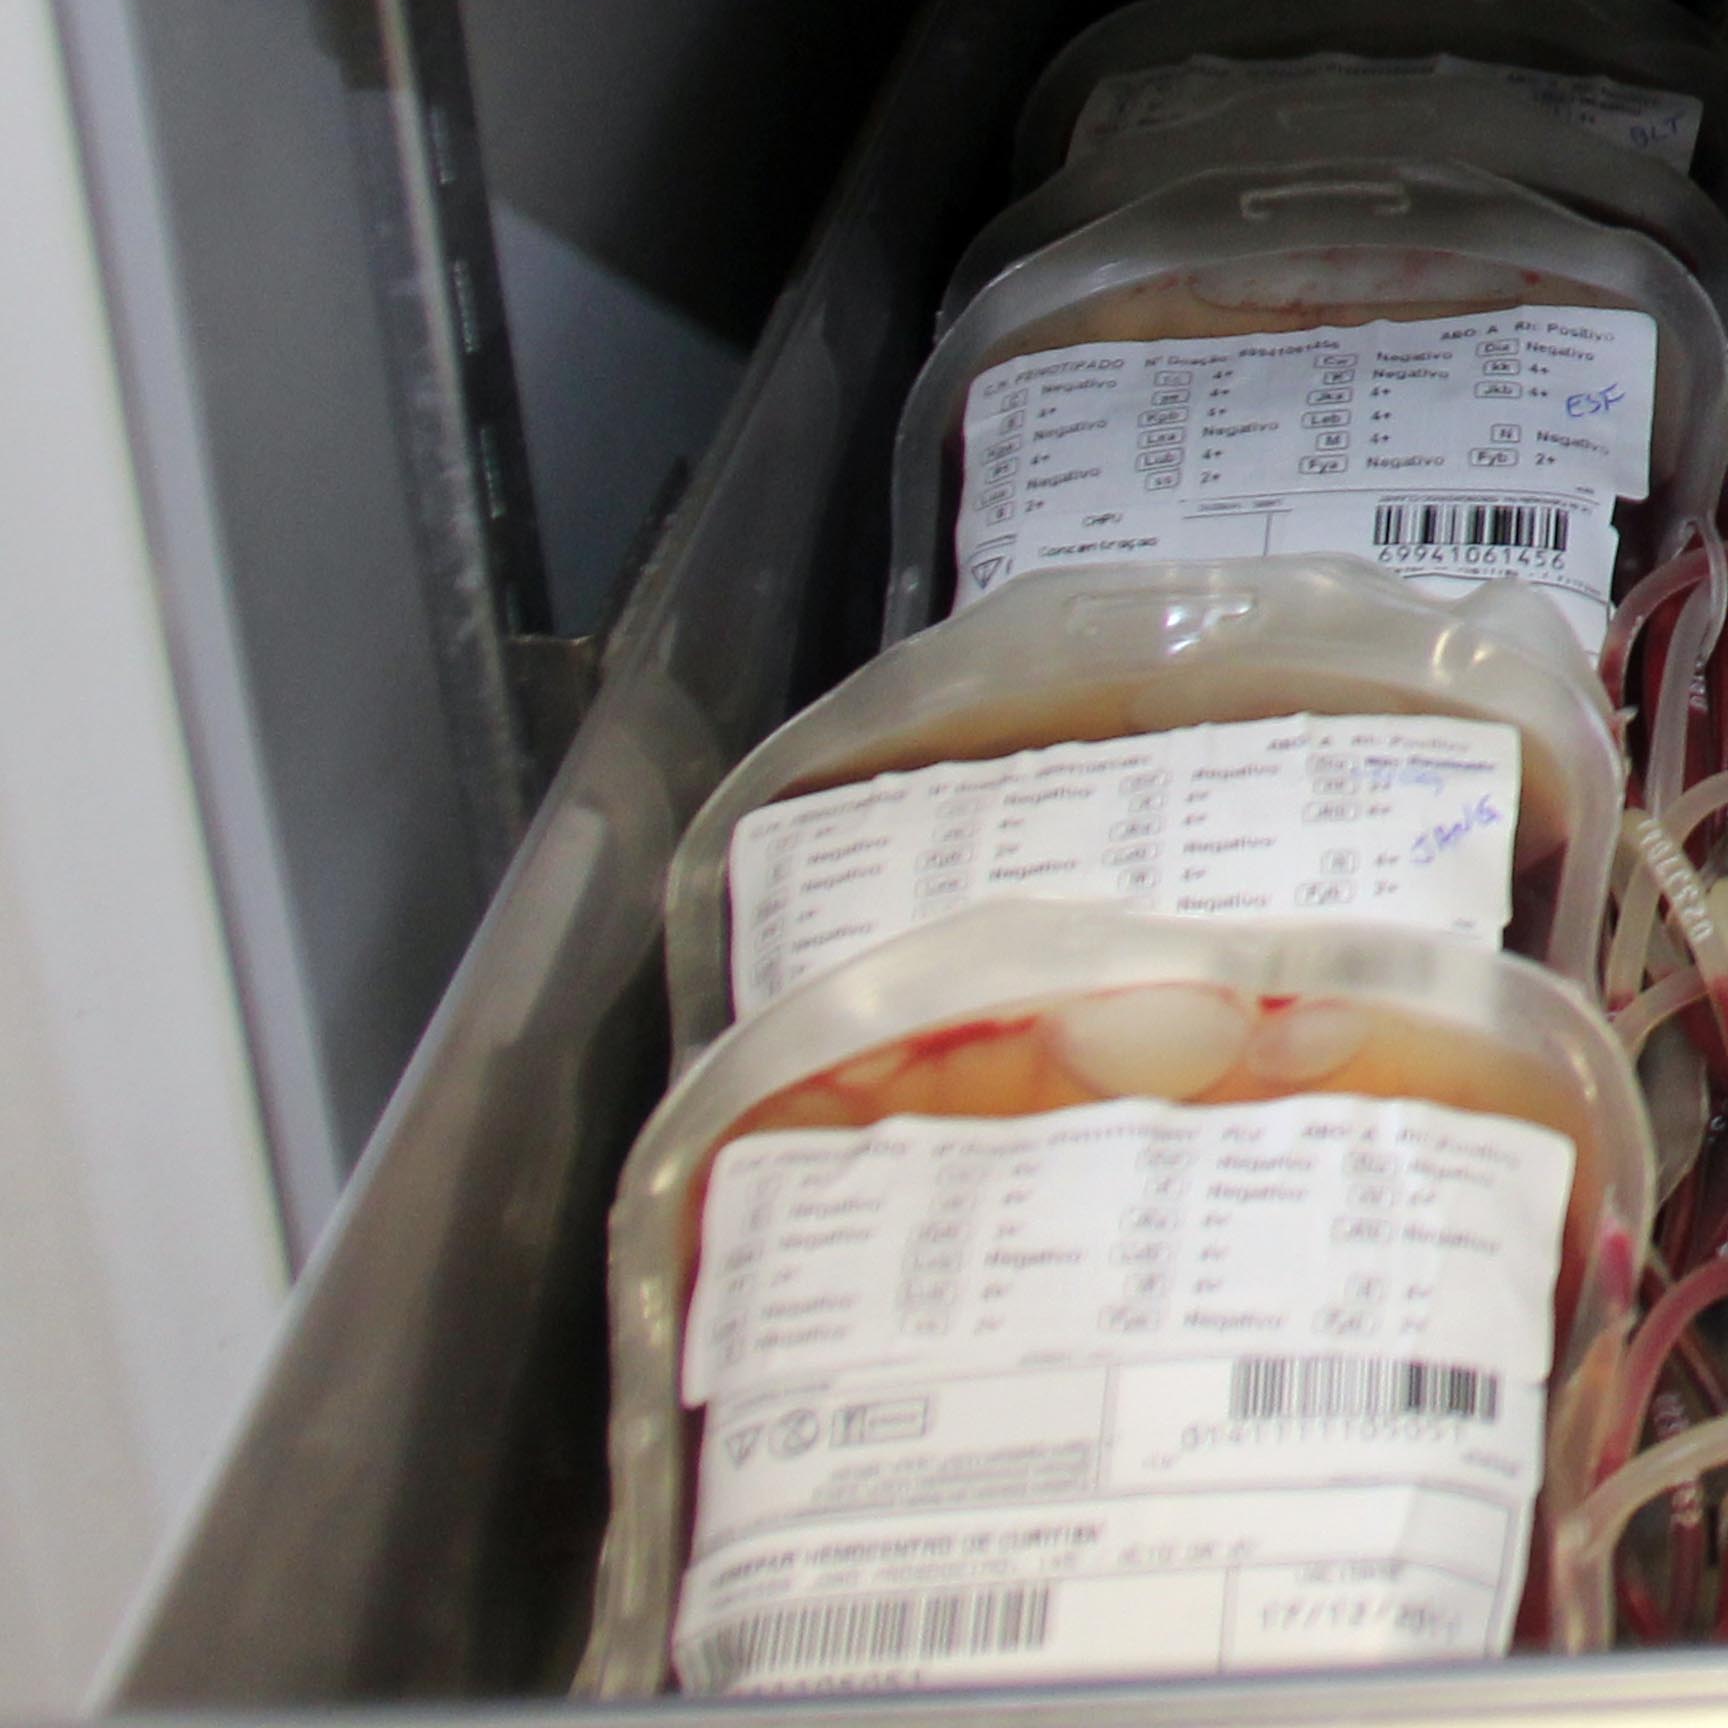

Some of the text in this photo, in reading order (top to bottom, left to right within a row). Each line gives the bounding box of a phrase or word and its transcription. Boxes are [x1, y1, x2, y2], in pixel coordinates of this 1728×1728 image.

[1547, 323, 1616, 342] Positivo
[1377, 342, 1595, 362] Negativo Negativo
[1373, 369, 1450, 380] Negativo
[1203, 423, 1280, 438] Negativo
[1367, 456, 1446, 469] Negativo
[1378, 545, 1566, 570] 69941061456
